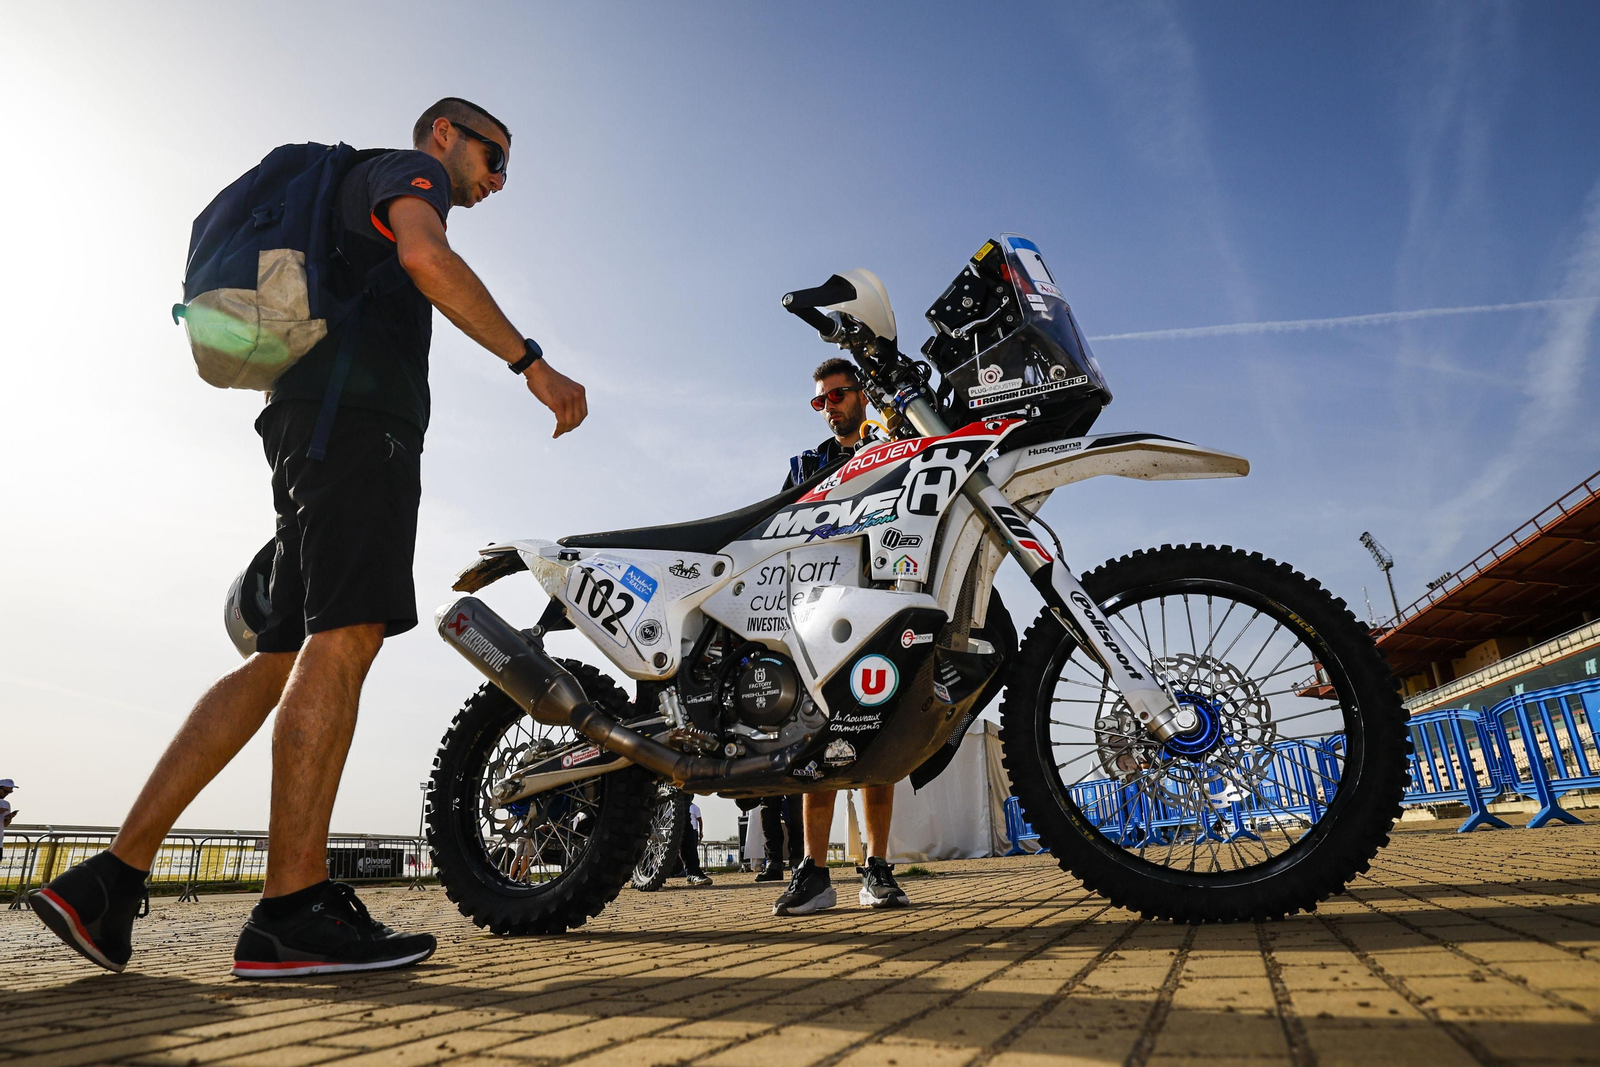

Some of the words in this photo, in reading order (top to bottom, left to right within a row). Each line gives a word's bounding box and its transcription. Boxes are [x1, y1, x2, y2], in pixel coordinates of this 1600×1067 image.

[970, 381, 1021, 396] PLUG-INDUSTRY
[982, 390, 1019, 405] ROMAIN
[1020, 379, 1075, 398] DUMONTIER
[846, 439, 922, 474] ROUEN
[1028, 441, 1082, 456] Husqvarna
[818, 479, 838, 492] KFC
[762, 488, 904, 540] MOVE
[858, 509, 897, 532] Team
[756, 555, 841, 586] smart
[628, 579, 647, 594] RALLY
[574, 567, 634, 637] 102
[750, 590, 805, 611] cube
[1070, 590, 1146, 681] Polisport
[460, 626, 512, 673] AKRAPOVIČ
[748, 681, 772, 689] FACTORY
[861, 668, 886, 696] U
[741, 689, 780, 699] REKLUSE
[365, 856, 391, 866] Diverse
